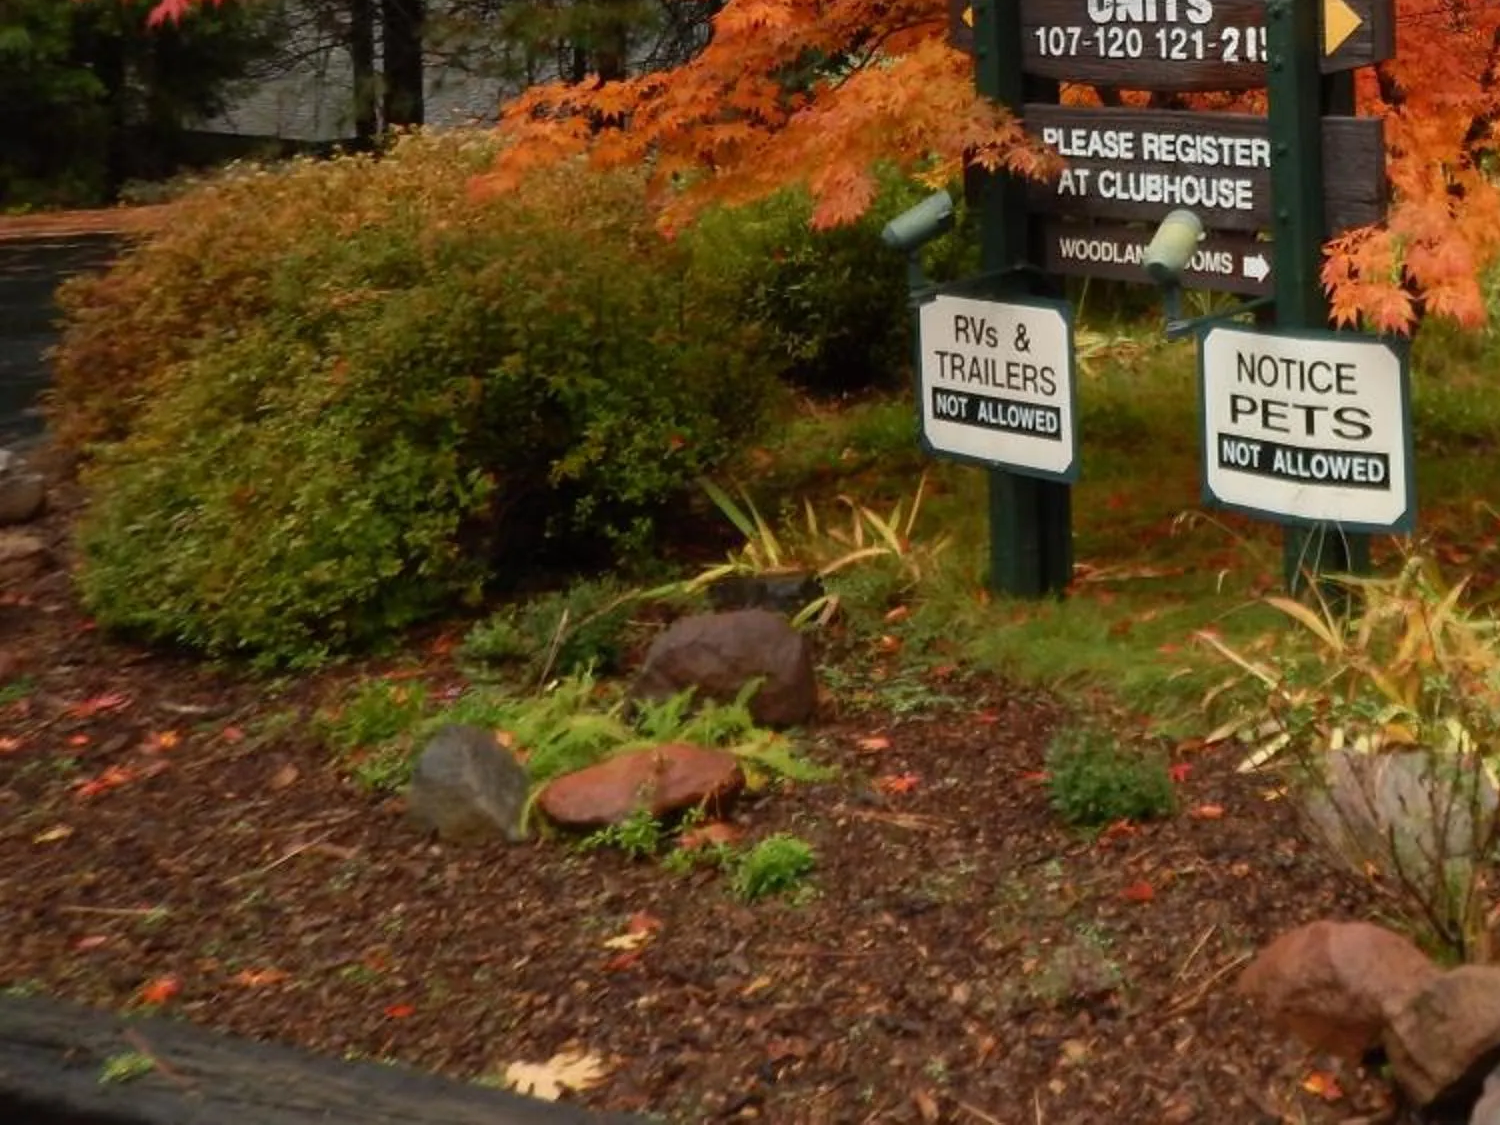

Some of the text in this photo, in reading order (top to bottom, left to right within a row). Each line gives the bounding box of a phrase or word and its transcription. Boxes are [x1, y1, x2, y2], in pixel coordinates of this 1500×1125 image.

[1035, 26, 1143, 58] 107-120
[1043, 127, 1271, 168] PLEASE REGISTER
[1057, 168, 1254, 210] AT CLUBHOUSE
[1059, 237, 1150, 265] WOODLAN
[954, 314, 1031, 353] RVs &
[934, 350, 1057, 397] TRAILERS
[1237, 350, 1358, 396] NOTICE
[936, 393, 1058, 434] NOT ALLOWED
[1230, 393, 1373, 441] PETS
[1222, 439, 1385, 483] NOT ALLOWED
